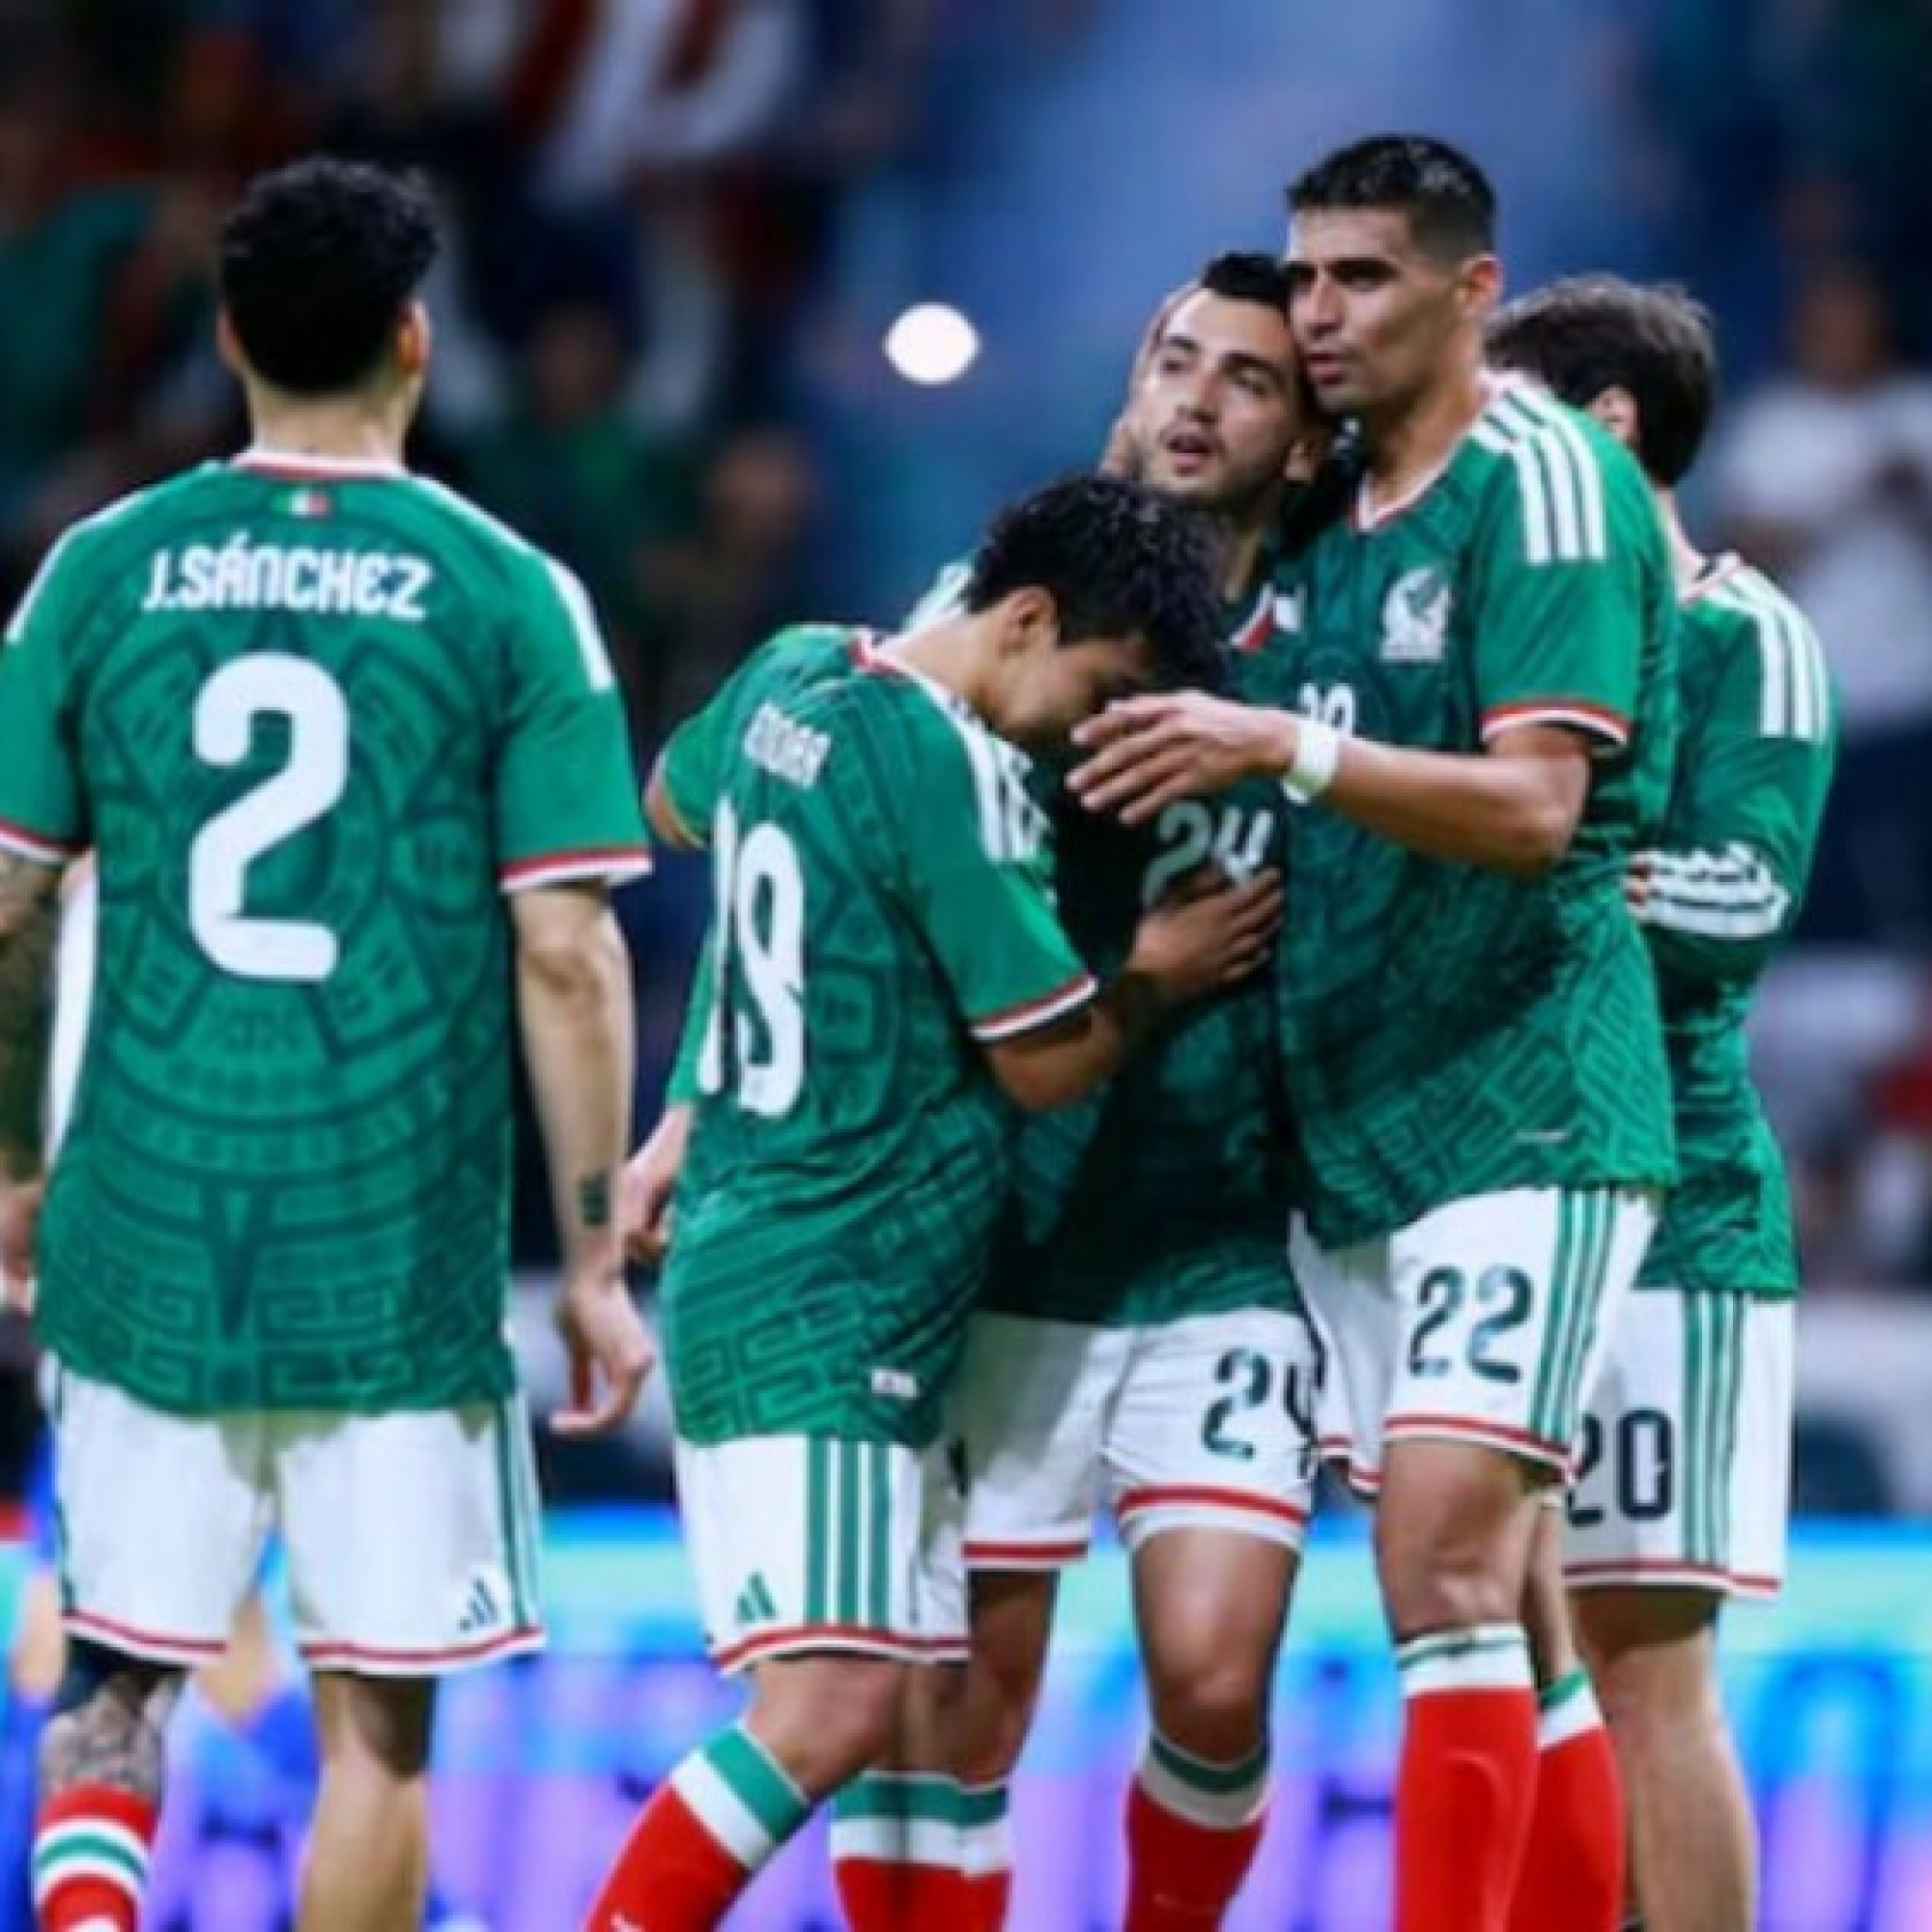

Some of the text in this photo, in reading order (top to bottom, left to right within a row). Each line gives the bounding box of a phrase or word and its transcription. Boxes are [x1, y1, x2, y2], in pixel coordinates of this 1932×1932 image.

[188, 651, 349, 981] 2
[696, 794, 804, 1118] 19
[1407, 1266, 1534, 1385] 22
[1566, 1407, 1673, 1528] 20
